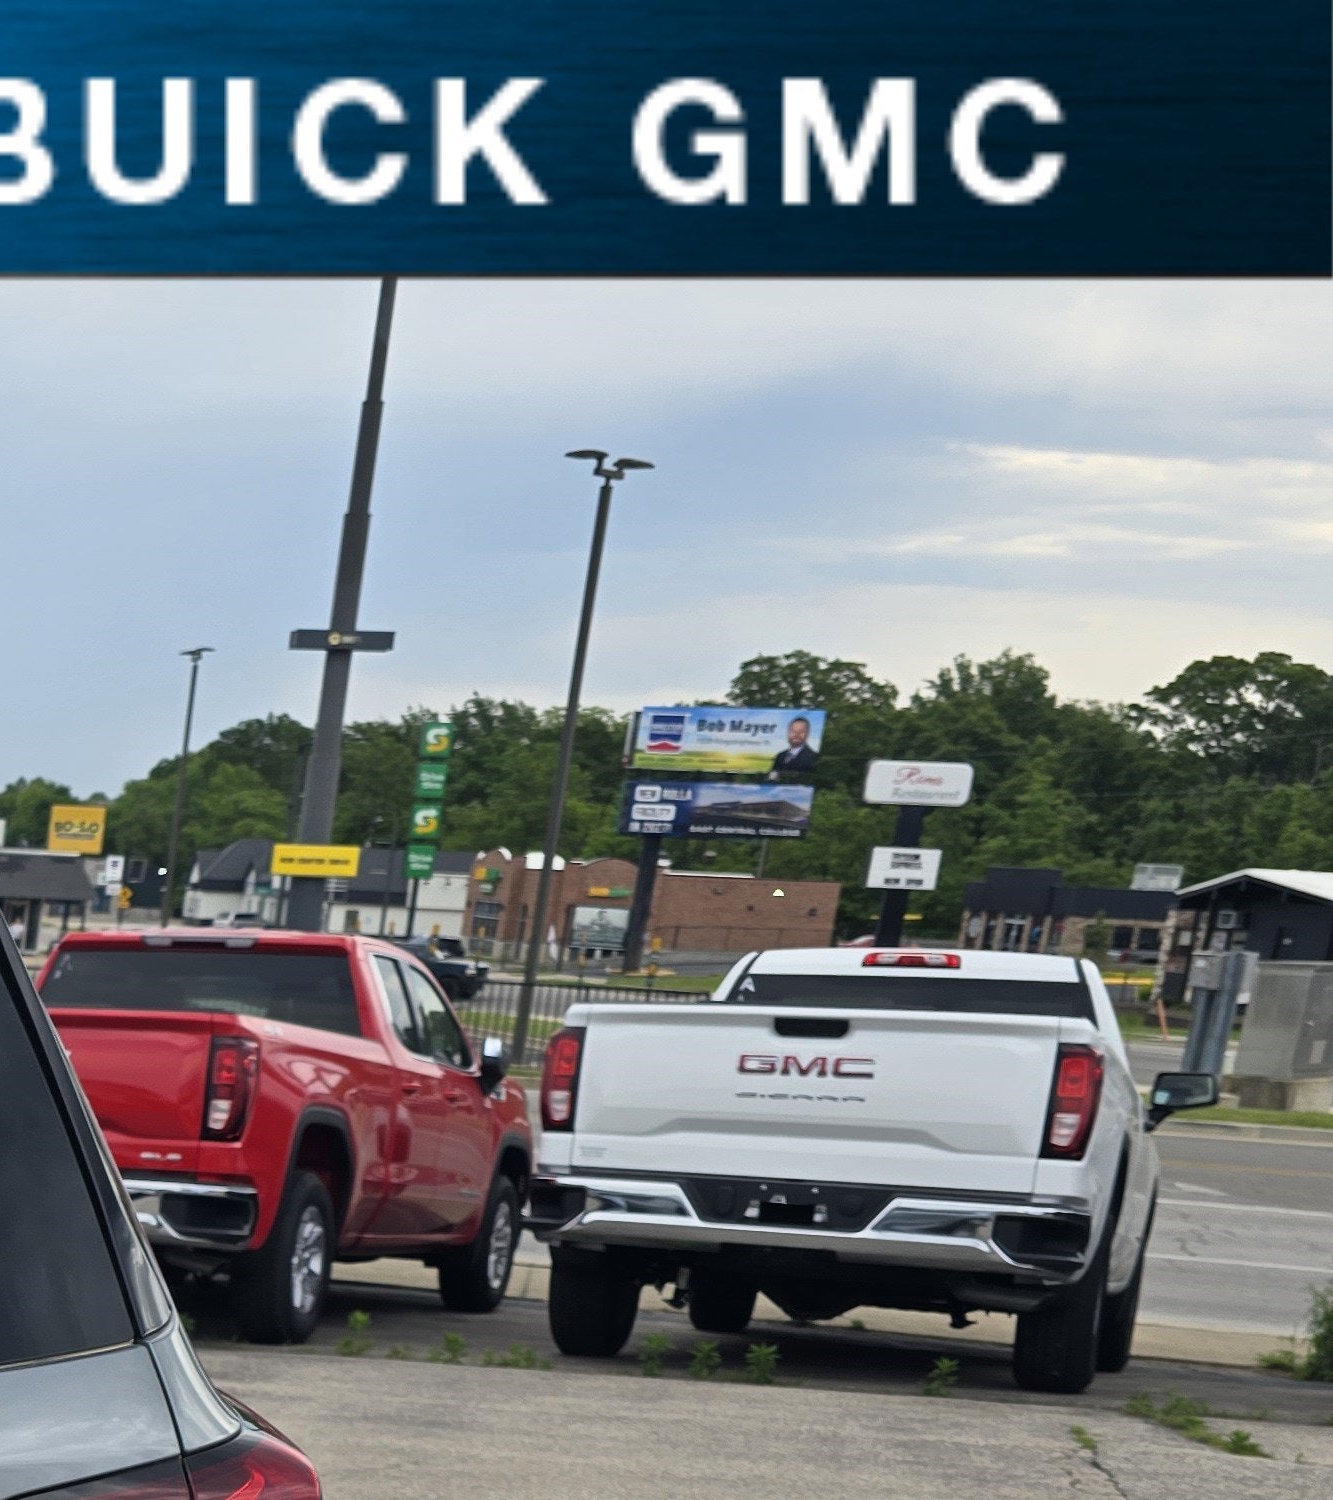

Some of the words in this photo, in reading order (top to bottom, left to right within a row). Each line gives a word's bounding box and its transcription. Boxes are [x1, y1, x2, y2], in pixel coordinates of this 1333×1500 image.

[696, 719, 726, 733] Bob
[729, 720, 778, 737] Mayer
[737, 1054, 876, 1079] GMC
